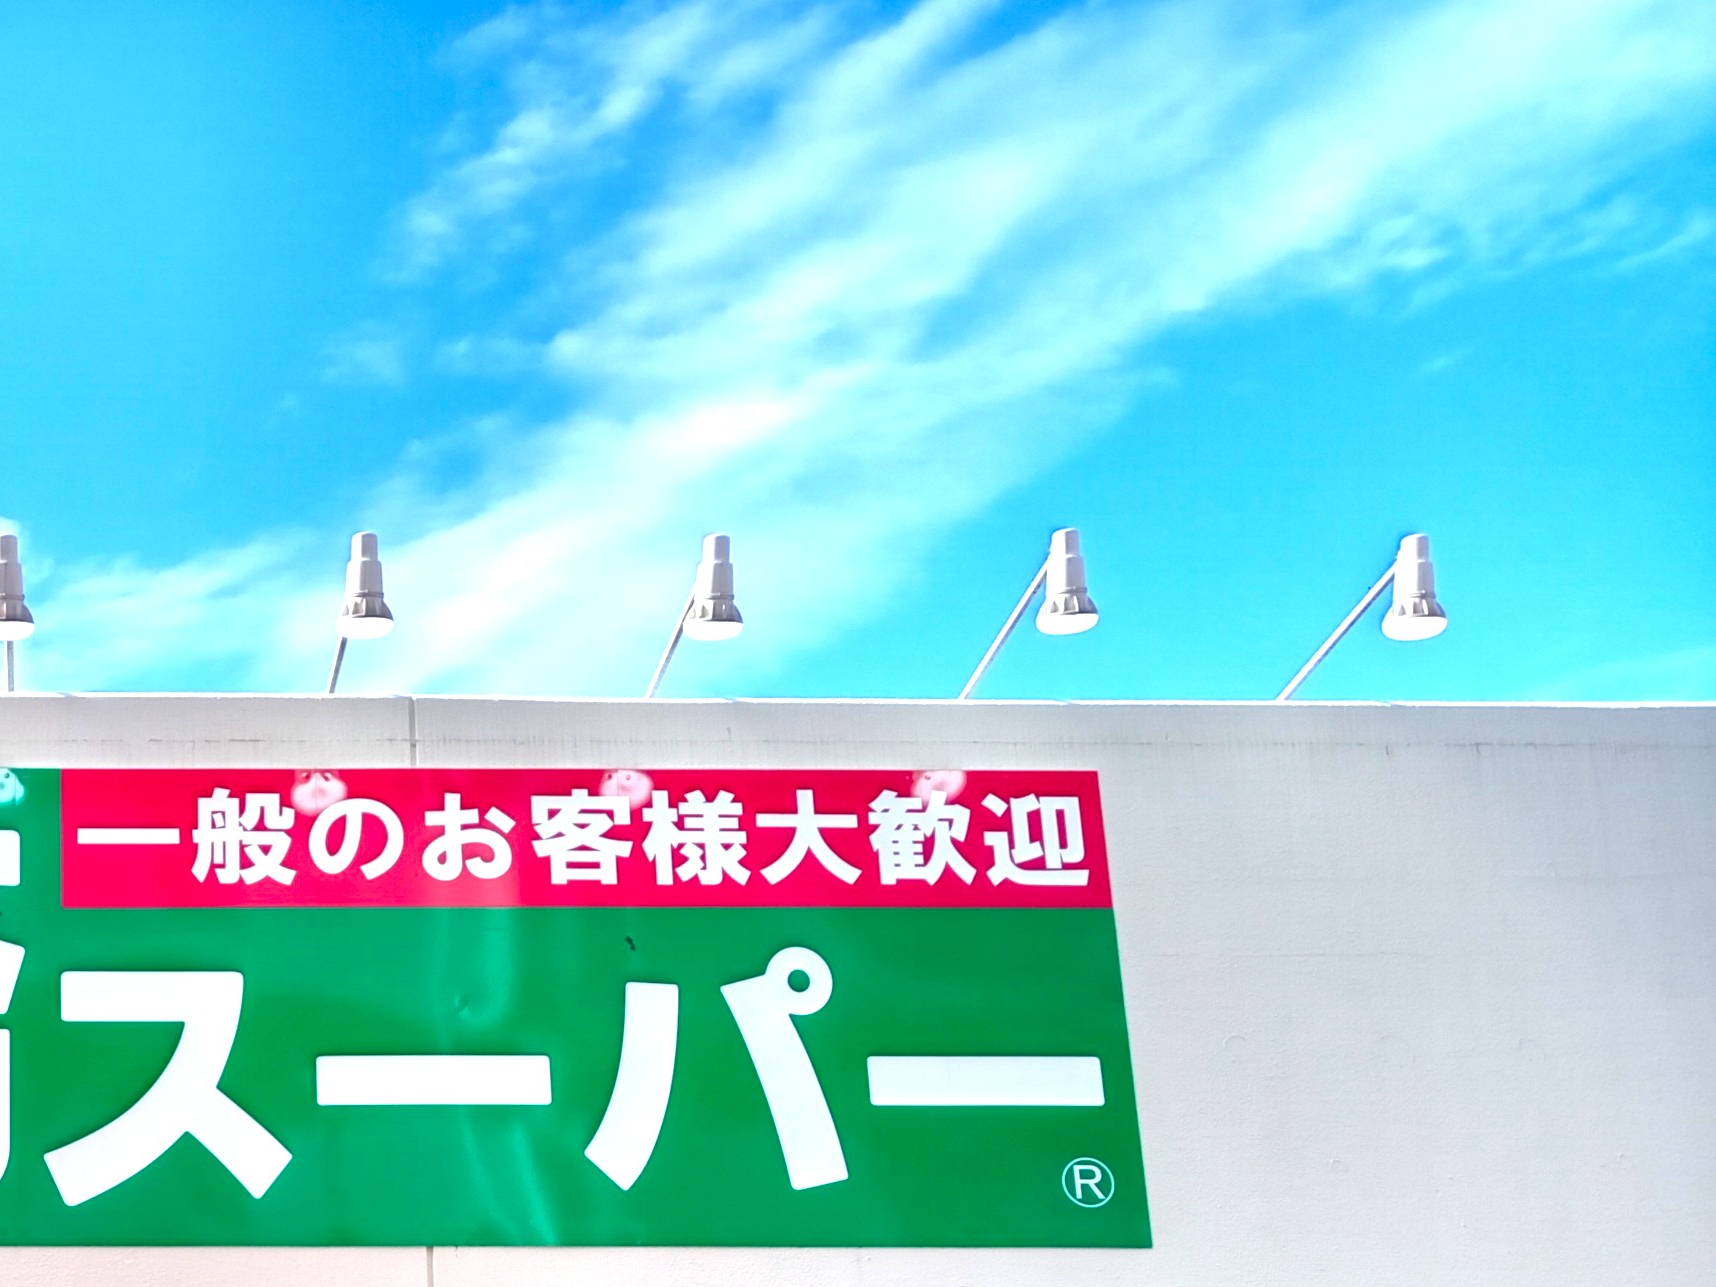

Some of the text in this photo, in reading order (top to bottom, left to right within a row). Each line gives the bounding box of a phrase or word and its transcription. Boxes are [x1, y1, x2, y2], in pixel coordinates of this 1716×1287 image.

[76, 784, 1092, 888] 一般のお客様大歓迎
